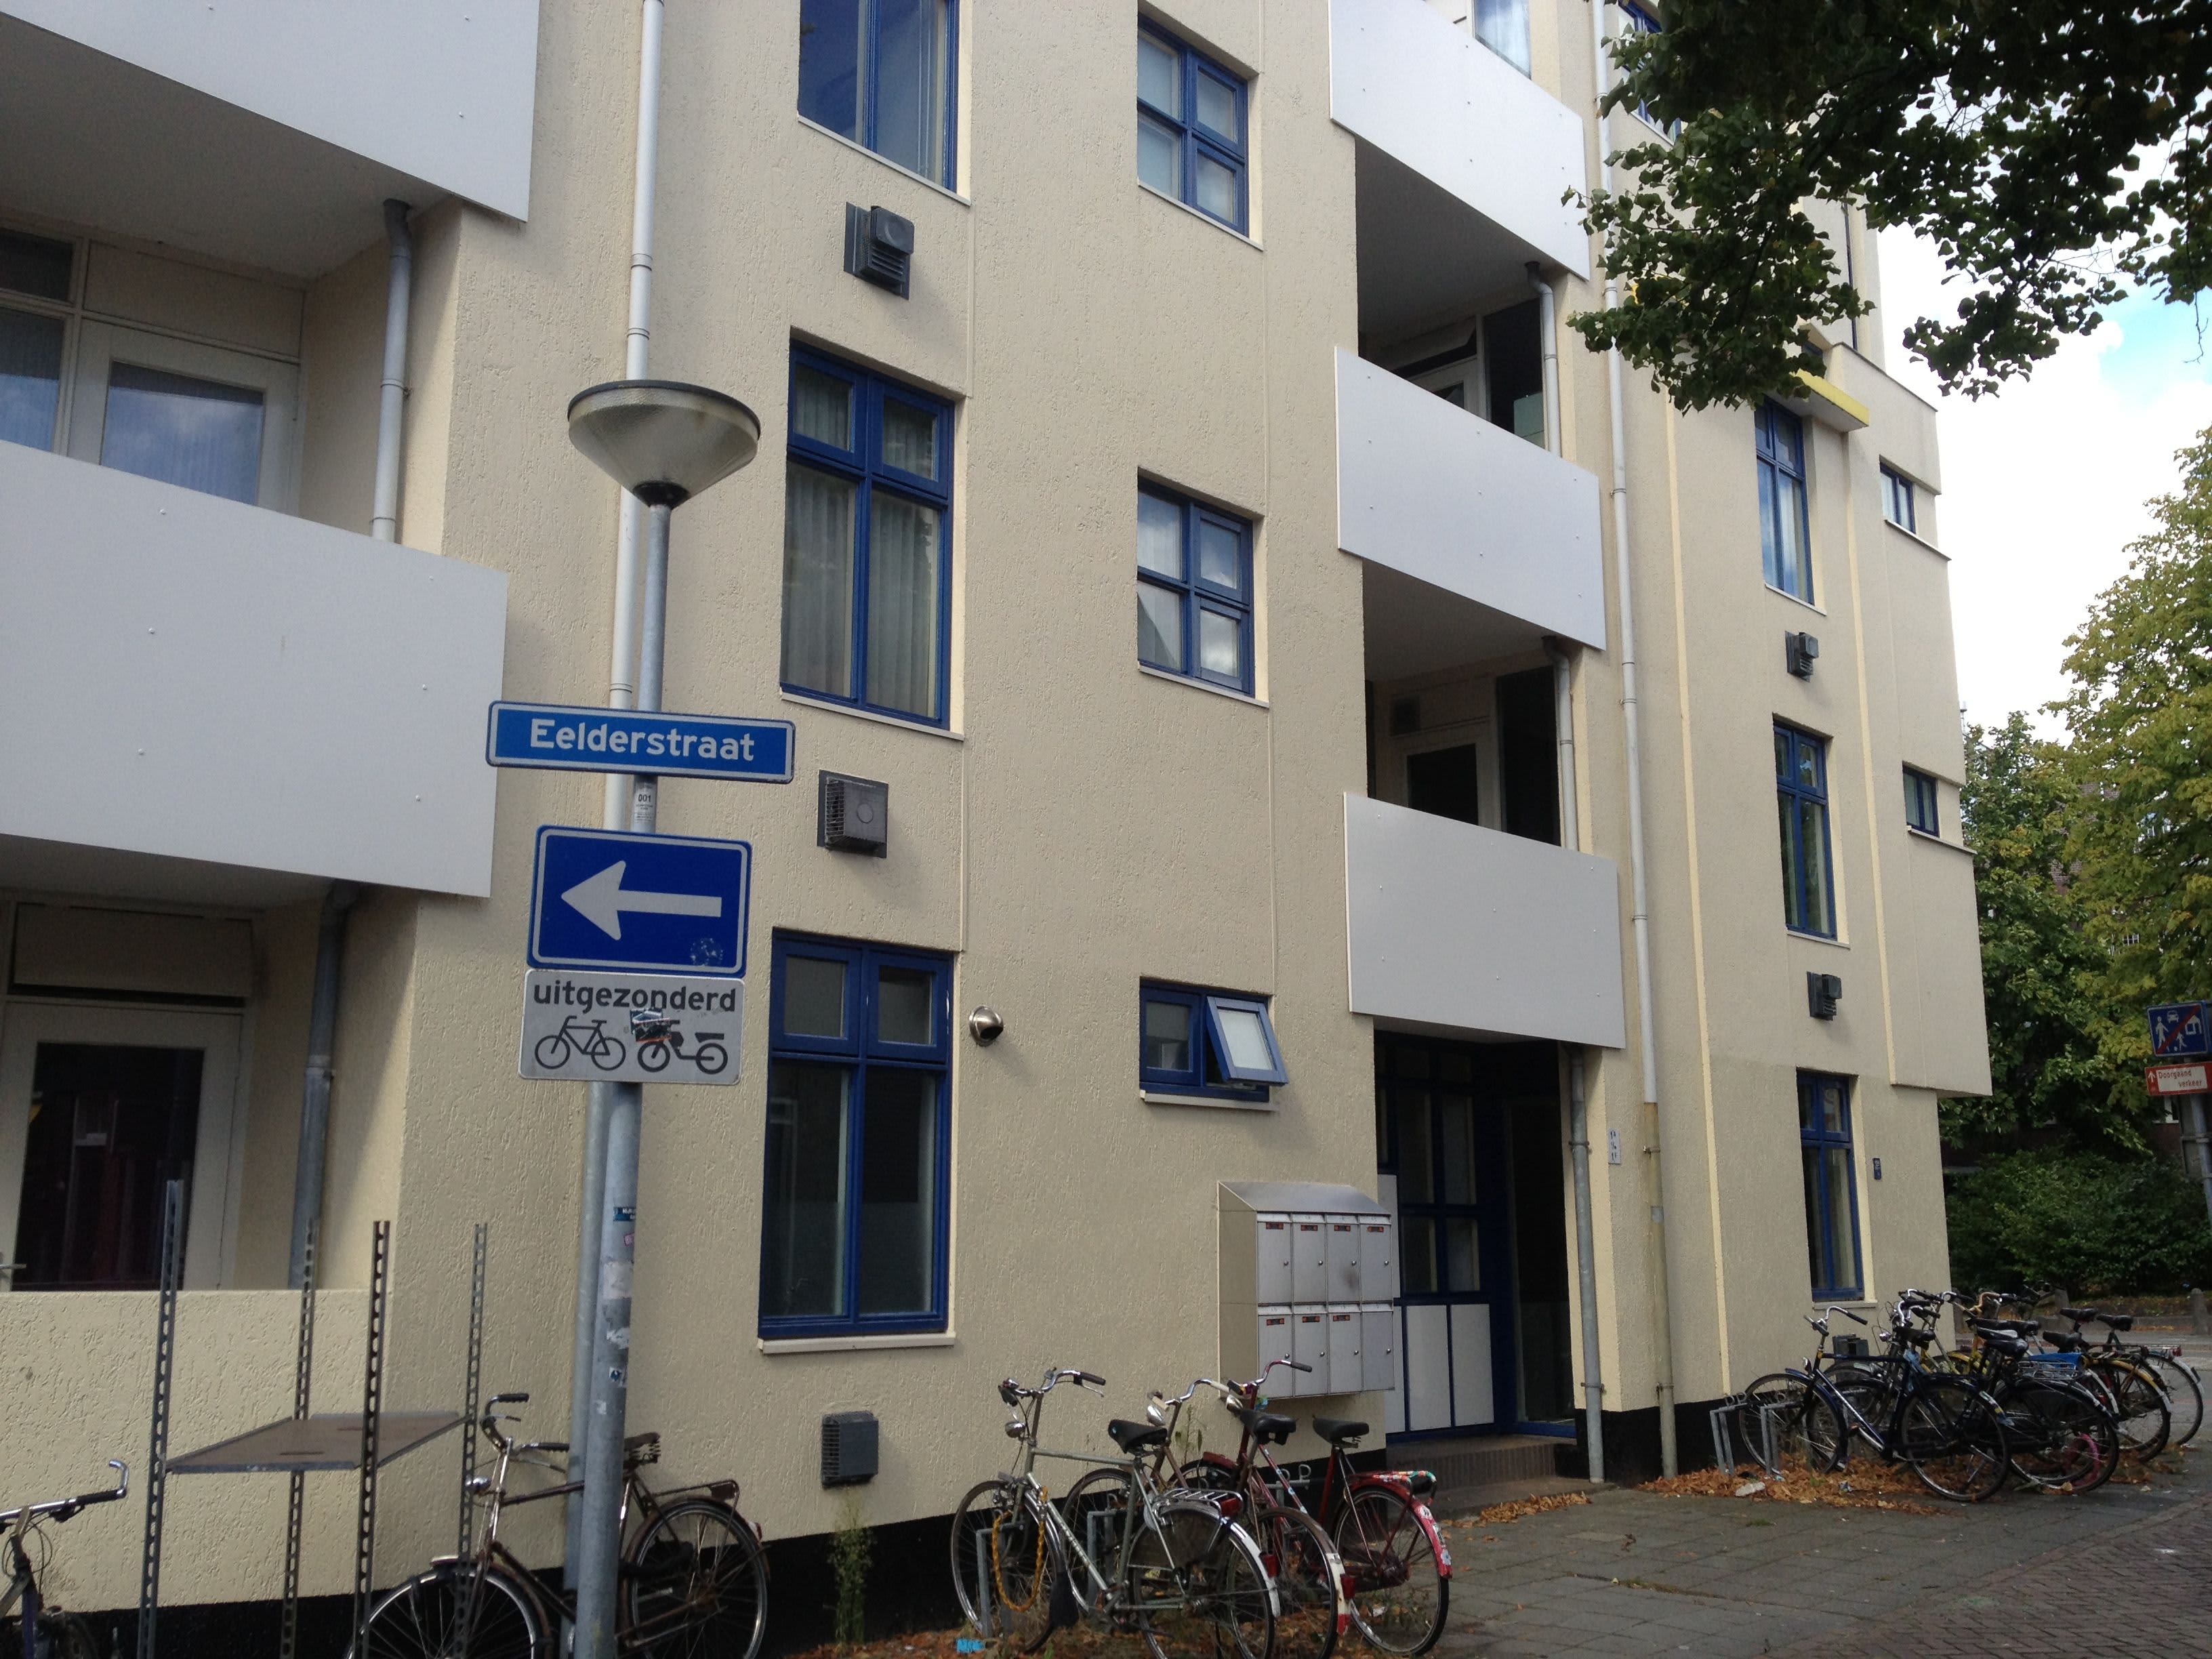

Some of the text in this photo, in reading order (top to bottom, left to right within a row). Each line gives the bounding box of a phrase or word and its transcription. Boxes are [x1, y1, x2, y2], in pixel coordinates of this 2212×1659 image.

[531, 718, 754, 762] Eelderstraat
[638, 794, 651, 802] 001
[533, 980, 736, 1015] uitgezonderd
[2158, 1069, 2192, 1079] Doorgaand
[2178, 1079, 2203, 1088] verkeer
